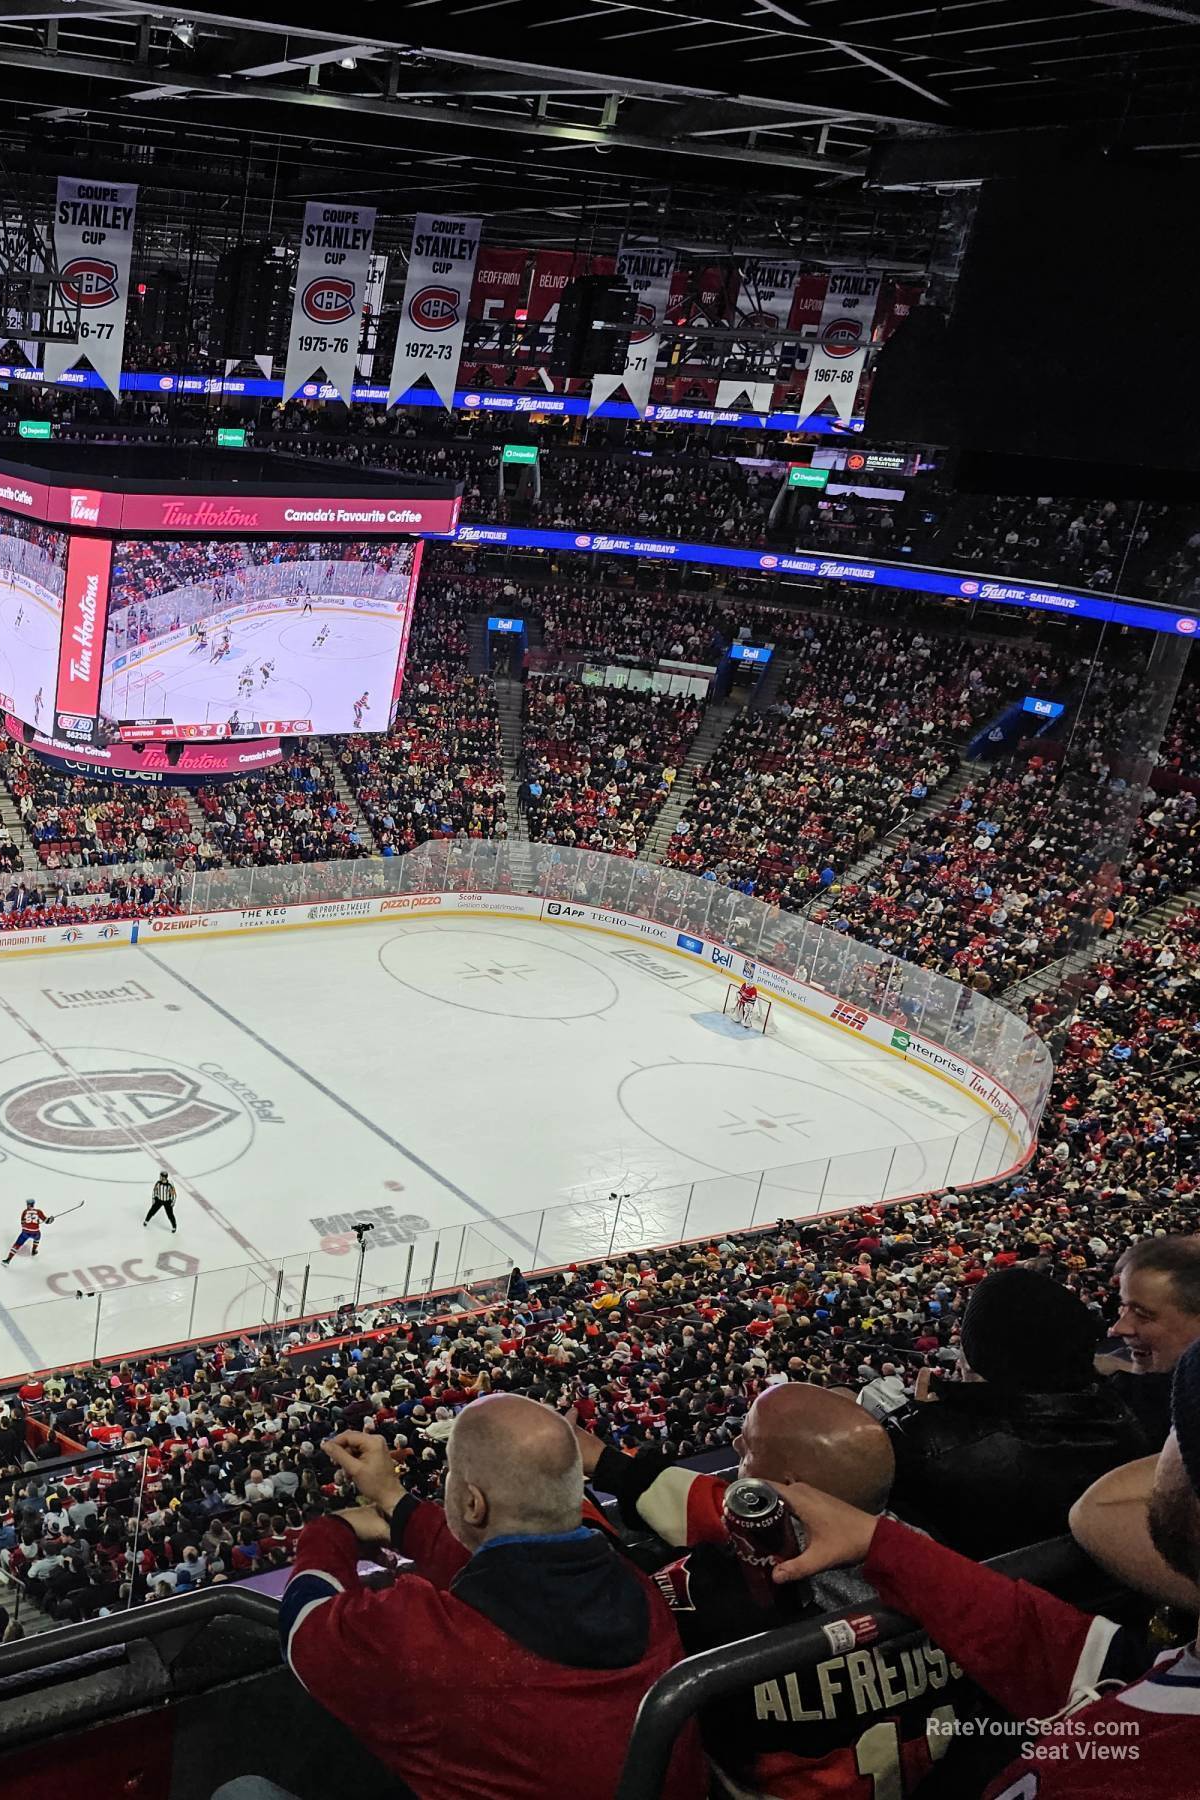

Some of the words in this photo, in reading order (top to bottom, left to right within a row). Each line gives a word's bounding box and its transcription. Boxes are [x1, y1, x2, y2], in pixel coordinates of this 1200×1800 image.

[78, 185, 118, 201] COUPE
[59, 201, 133, 230] STANLEY
[323, 209, 359, 224] COUPE
[432, 220, 465, 235] COUPE
[82, 230, 106, 246] CUP
[305, 224, 371, 251] STANLEY
[414, 234, 476, 261] STANLEY
[325, 252, 346, 265] CUP
[618, 255, 674, 278] STANLEY
[432, 261, 452, 274] CUP
[478, 270, 521, 286] GEOFFRION
[539, 271, 575, 288] BÉLIVE
[633, 279, 651, 291] CUP
[830, 275, 880, 296] STANLEY
[298, 336, 349, 353] 1975-76
[405, 342, 452, 360] 1972-73
[814, 368, 854, 383] 1967-68
[162, 502, 192, 525] Tim
[191, 502, 258, 526] Hortons
[284, 508, 334, 523] Canada's
[336, 509, 385, 523] Favourite
[387, 510, 422, 523] Coffee
[72, 575, 99, 648] Hortons
[497, 618, 513, 630] Bell
[742, 647, 759, 660] Bell
[70, 649, 92, 682] Tim
[1034, 702, 1052, 715] Bell
[380, 897, 410, 912] pizza
[411, 896, 442, 909] pizza
[459, 893, 482, 901] Scotia
[241, 910, 261, 918] THE
[266, 908, 287, 918] KEG
[31, 934, 47, 943] TIRE
[712, 947, 733, 968] Bell
[831, 1003, 868, 1031] IGA
[896, 1035, 965, 1076] enterprise
[968, 1071, 987, 1098] Tim
[46, 1259, 158, 1297] CIBC
[753, 1640, 964, 1722] ALFREDS
